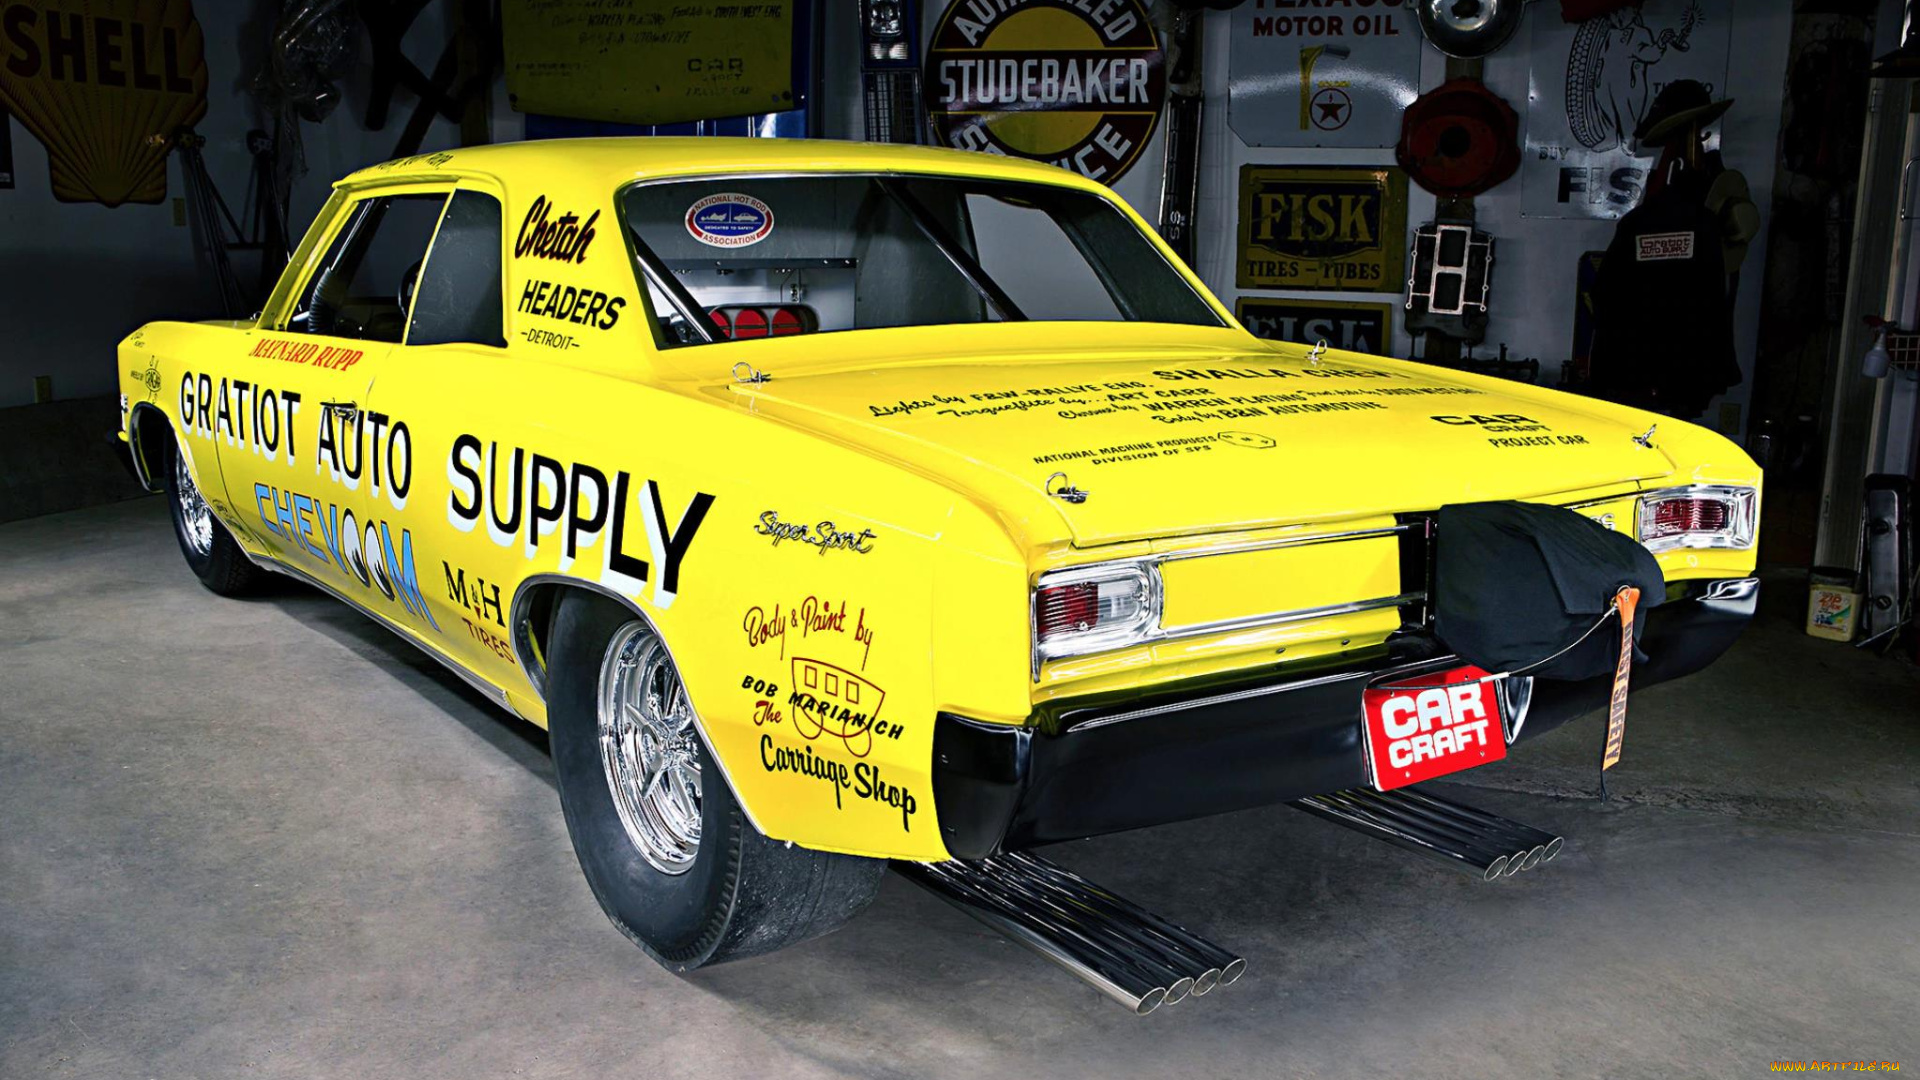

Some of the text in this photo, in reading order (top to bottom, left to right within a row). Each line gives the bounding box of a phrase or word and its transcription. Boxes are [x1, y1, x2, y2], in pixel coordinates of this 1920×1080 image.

[1253, 15, 1399, 36] MOTOR OIL
[4, 4, 194, 93] SHELL
[687, 58, 743, 73] CAR
[940, 58, 1149, 104] STUDEBAKER
[1539, 147, 1570, 161] BUY
[1558, 167, 1643, 204] FIS
[694, 195, 767, 213] NATIONAL HOT ROD
[1257, 193, 1373, 242] FISK
[515, 194, 601, 264] Chetah
[702, 233, 757, 246] ASSOCIATION
[1640, 247, 1661, 255] AUTO
[1249, 261, 1299, 279] TIRES
[1323, 262, 1381, 280] TUBES
[518, 279, 626, 330] HEADERS
[249, 339, 364, 371] MAYNARD RUPP
[1152, 369, 1302, 381] SHALLA
[868, 400, 936, 418] Lights
[932, 395, 967, 404] by
[1107, 391, 1150, 402] ART
[1154, 387, 1216, 398] CARR
[1142, 396, 1228, 412] WARREN
[1230, 391, 1308, 405] PLATING
[1267, 402, 1389, 415] AUTOMOTIVE
[1430, 414, 1539, 426] CAR
[1033, 449, 1097, 465] NATIONAL
[1099, 442, 1155, 456] MACHINE
[1157, 435, 1217, 448] PRODUCTS
[1092, 452, 1158, 465] DIVISION
[1162, 448, 1181, 456] OF
[1488, 434, 1590, 448] PROJECT CAR
[179, 371, 716, 606] GRATIOT AUTO SUPPLY
[809, 521, 877, 556] Sport
[254, 482, 442, 633] CHEVOOM
[442, 560, 507, 628] M&H
[462, 617, 515, 664] TIRES
[743, 596, 873, 671] Body & Paint by
[741, 675, 904, 740] BOB MARIANICH
[753, 700, 782, 726] The
[1380, 682, 1486, 739] CAR
[1604, 686, 1628, 763] SAFETY
[1388, 719, 1489, 769] CRAFT
[760, 733, 917, 832] Carriage Shop
